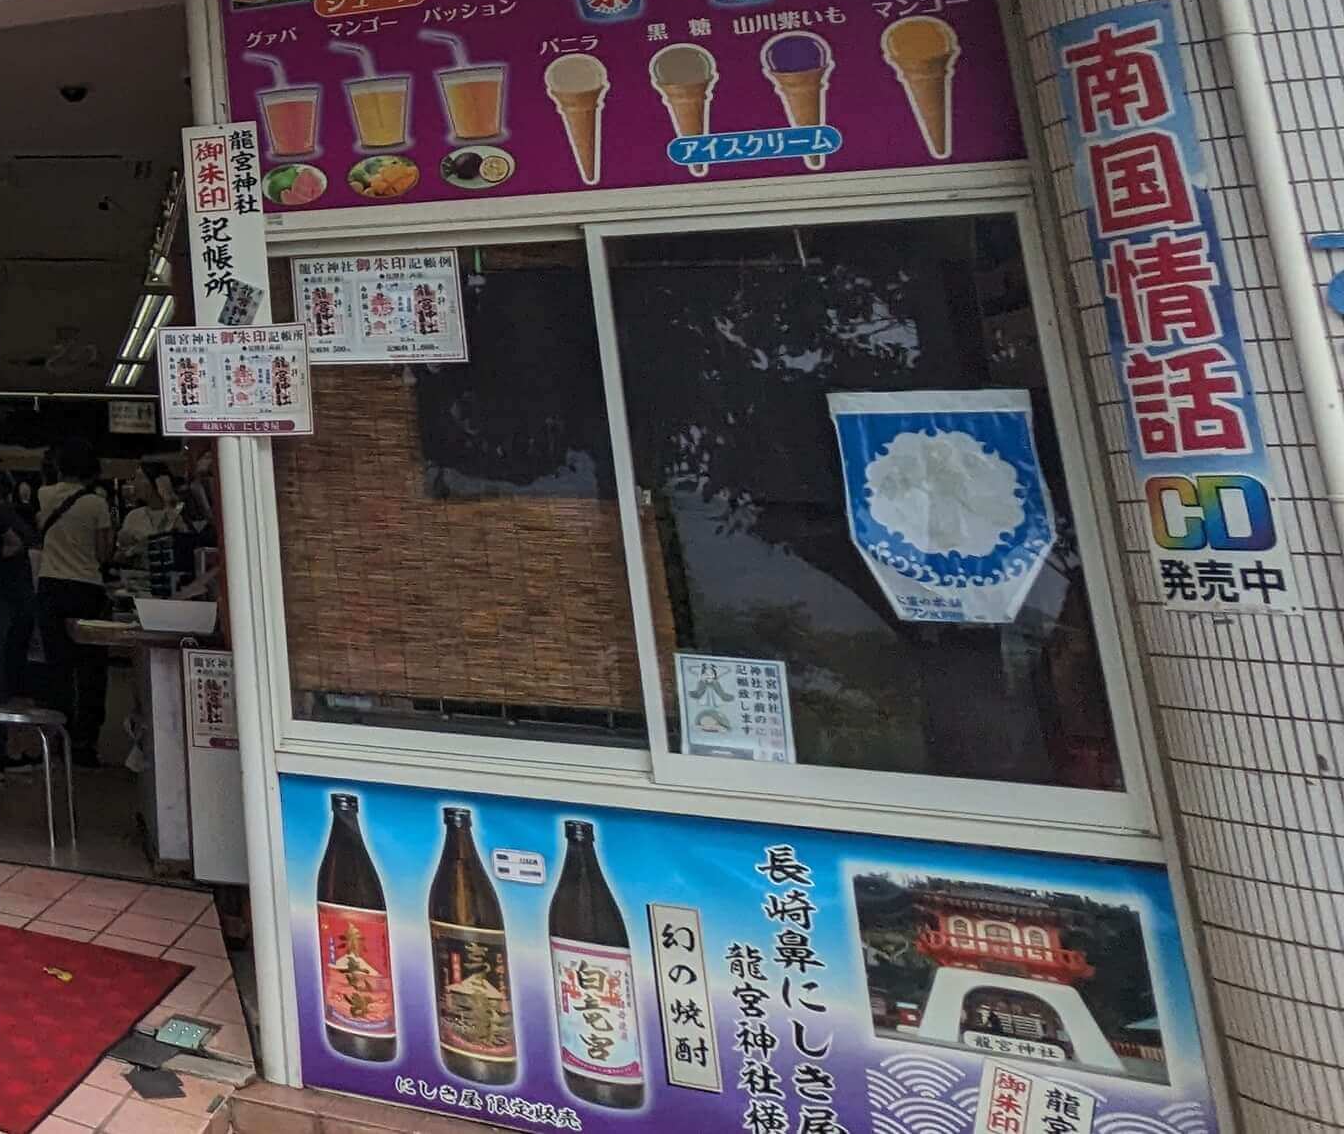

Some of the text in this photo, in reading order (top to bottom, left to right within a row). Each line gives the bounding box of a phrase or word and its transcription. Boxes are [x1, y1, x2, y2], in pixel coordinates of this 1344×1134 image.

[245, 26, 298, 49] グァバ
[328, 17, 399, 37] マンゴー
[539, 34, 600, 55] バニラ
[732, 5, 847, 36] 山川紫いも
[679, 128, 833, 161] アイスクリーム
[228, 129, 262, 216] 龍宮神社
[194, 141, 235, 299] 御朱印 記帳所
[1063, 22, 1252, 458] 南国情話
[1145, 473, 1278, 553] CD
[1159, 558, 1287, 606] 発売中
[661, 921, 710, 1069] 幻の焼酎
[723, 942, 789, 1134] 龍宮神社横
[975, 1036, 1059, 1060] 龍宮神社
[394, 1073, 584, 1132] にしき屋限定販売
[989, 1071, 1027, 1134] 御朱印
[1042, 1085, 1082, 1134] 龍宮
